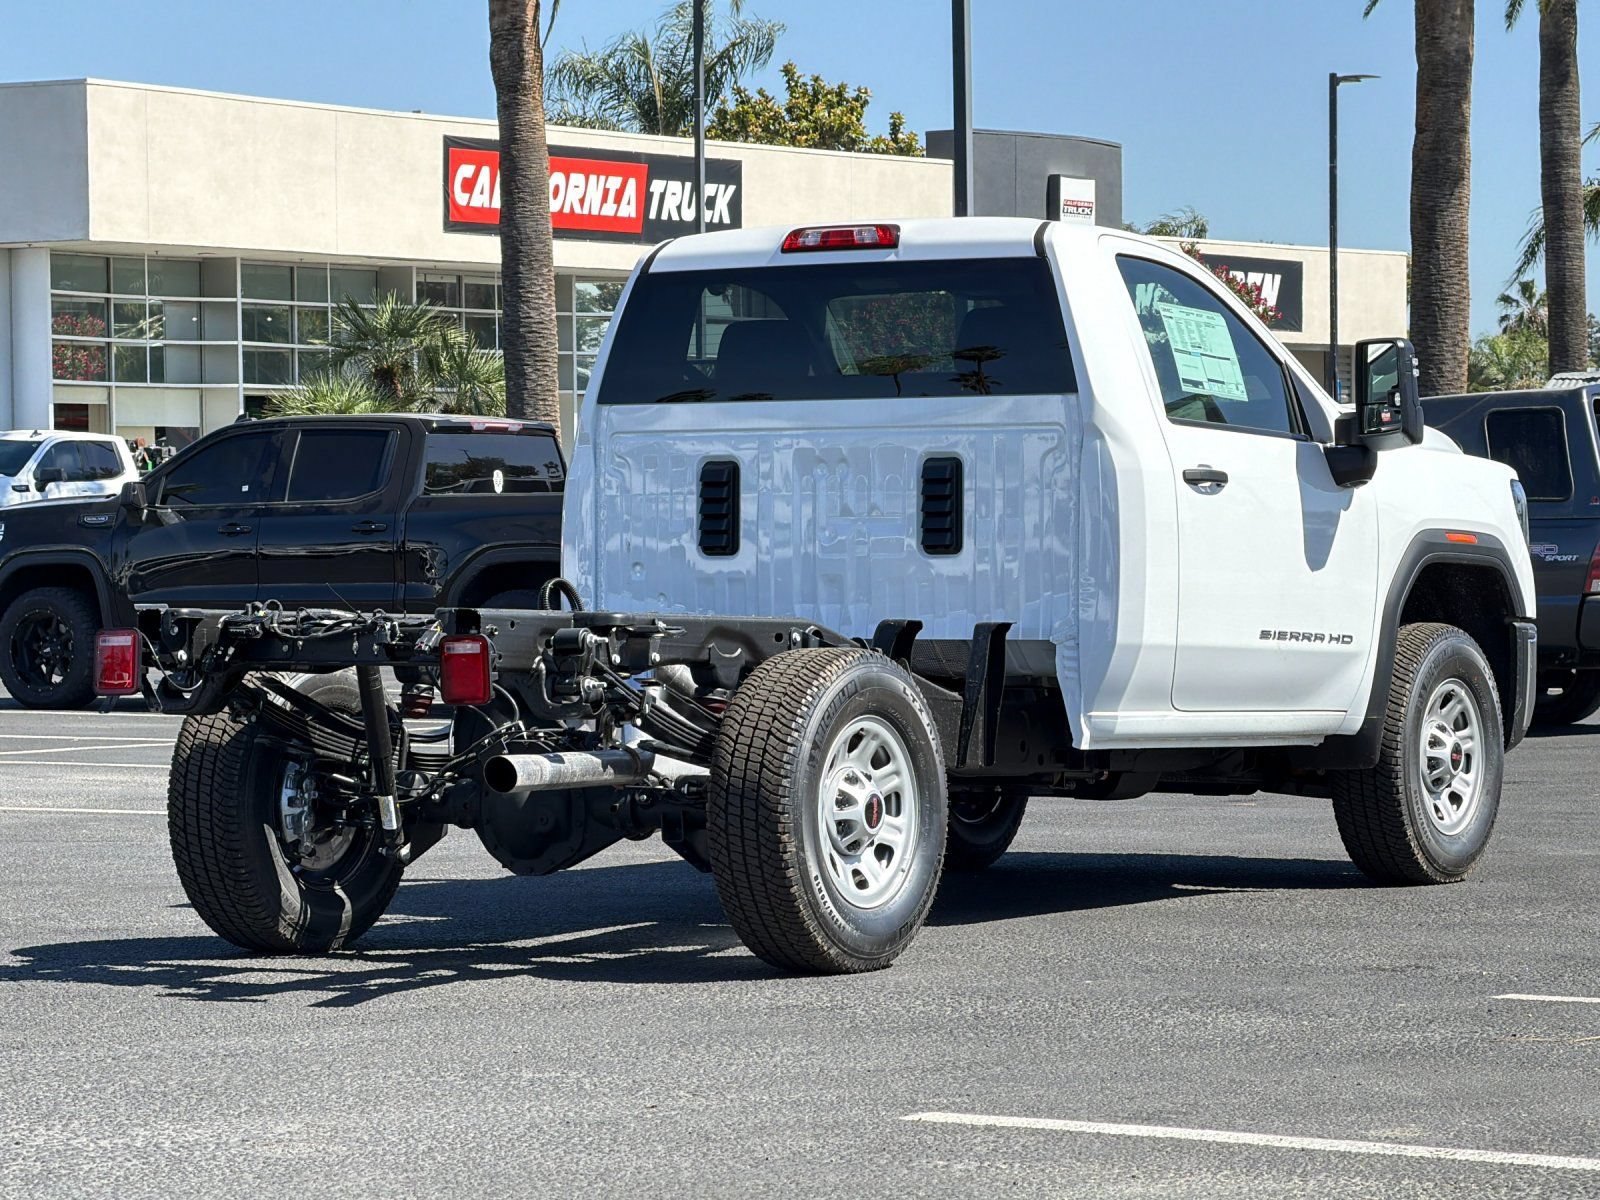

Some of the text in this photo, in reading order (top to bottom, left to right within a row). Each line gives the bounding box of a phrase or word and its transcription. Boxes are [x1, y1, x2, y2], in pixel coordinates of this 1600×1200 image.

[453, 163, 737, 224] CAORNIA TRUCK
[1063, 206, 1092, 215] TRUCK
[1529, 544, 1558, 557] RD
[1259, 629, 1353, 645] SIERRA HD
[814, 680, 858, 749] MICHELIN
